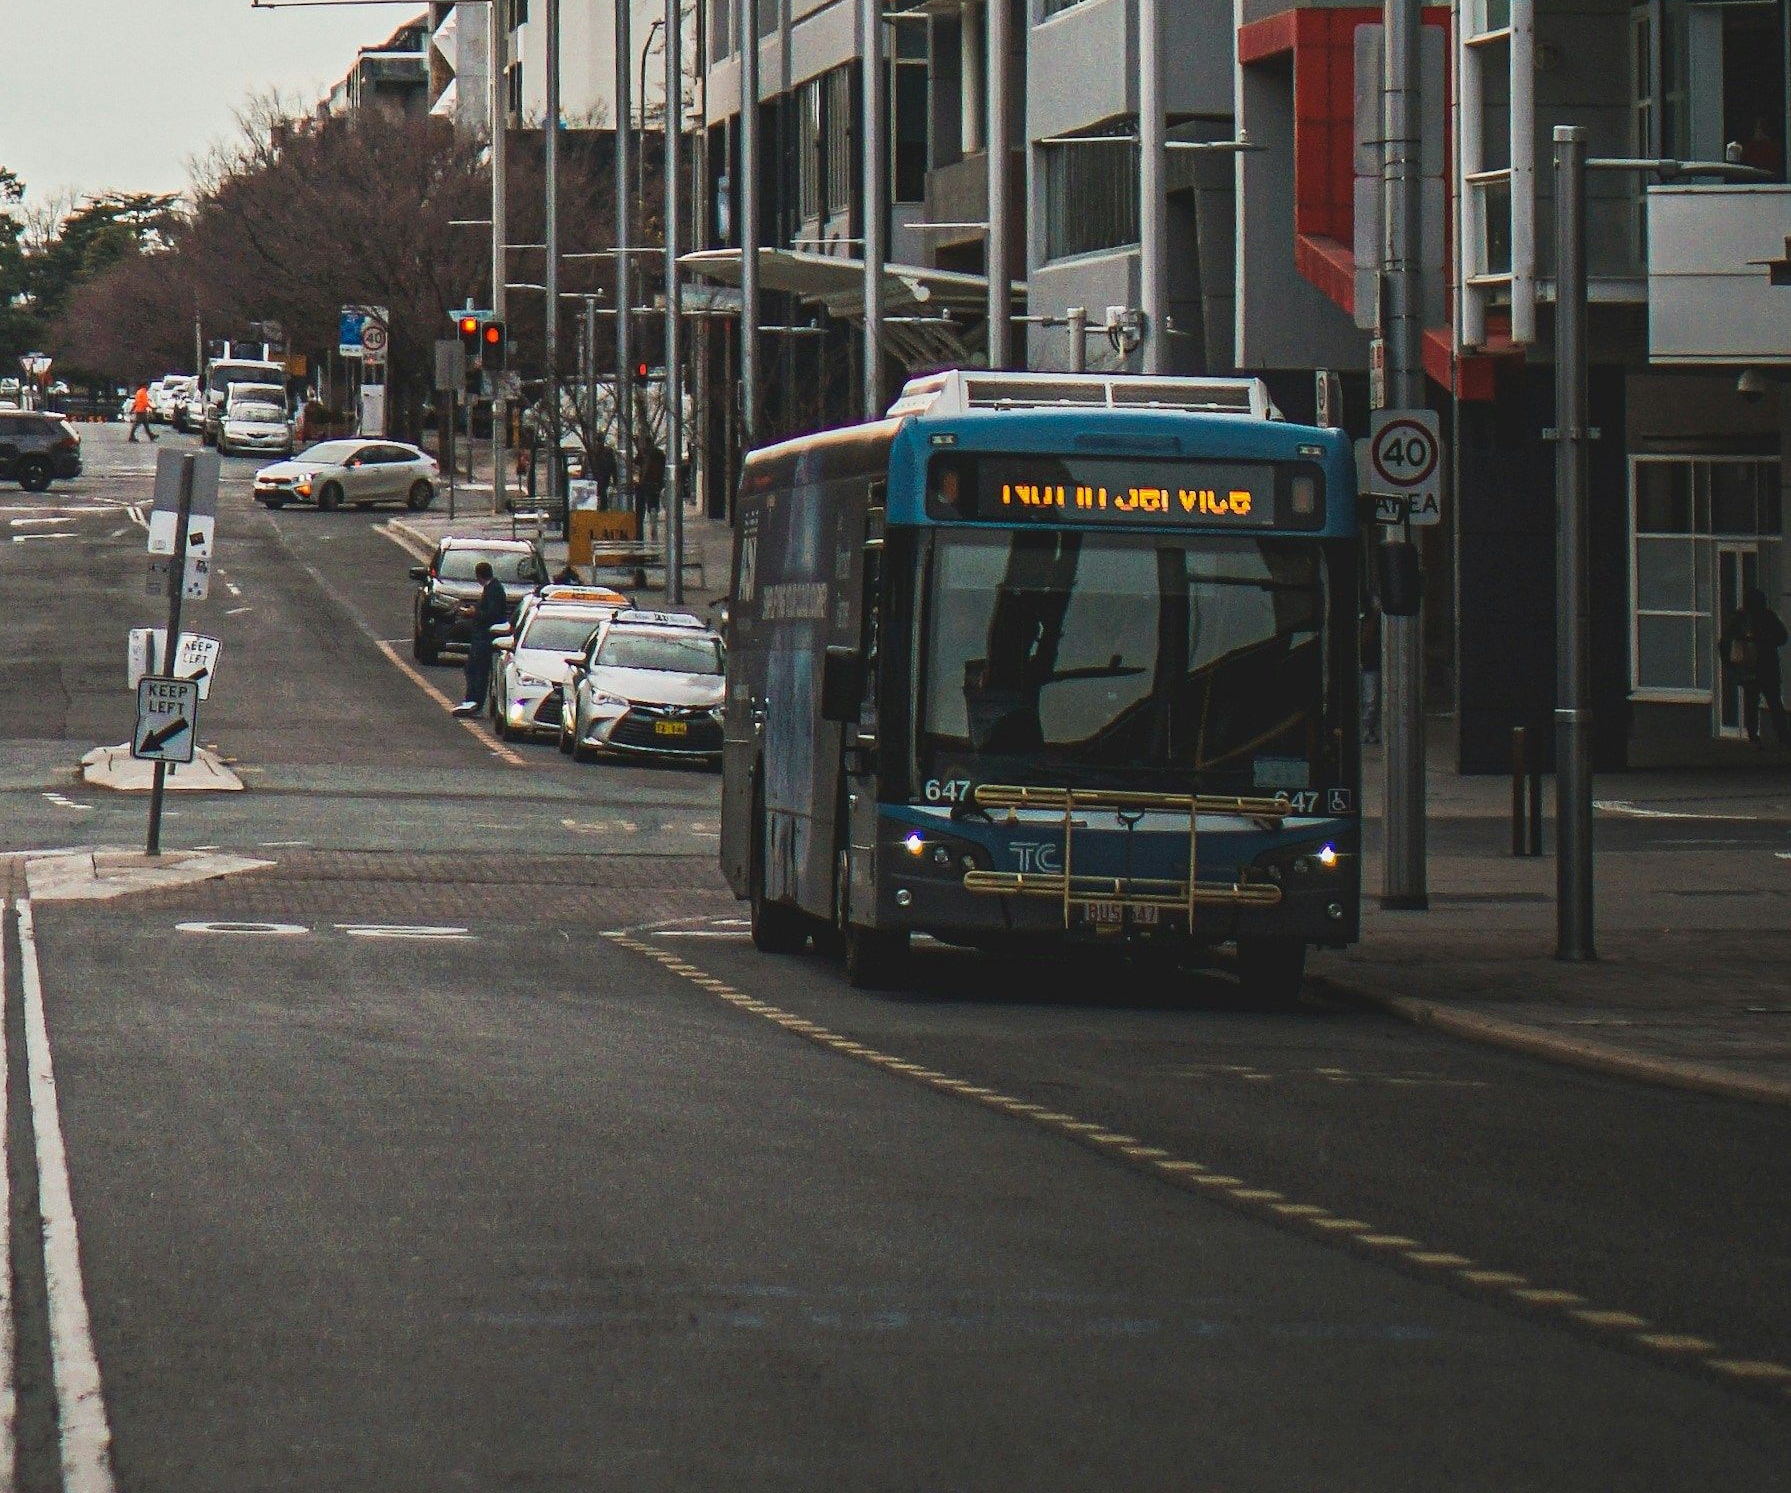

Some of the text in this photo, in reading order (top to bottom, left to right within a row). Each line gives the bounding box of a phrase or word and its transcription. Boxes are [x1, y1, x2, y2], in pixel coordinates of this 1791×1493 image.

[1382, 437, 1427, 467] 40
[184, 640, 213, 653] KEEP
[149, 683, 188, 698] KEEP
[149, 700, 185, 715] LEFT
[925, 779, 971, 802] 647
[1009, 841, 1062, 874] TC
